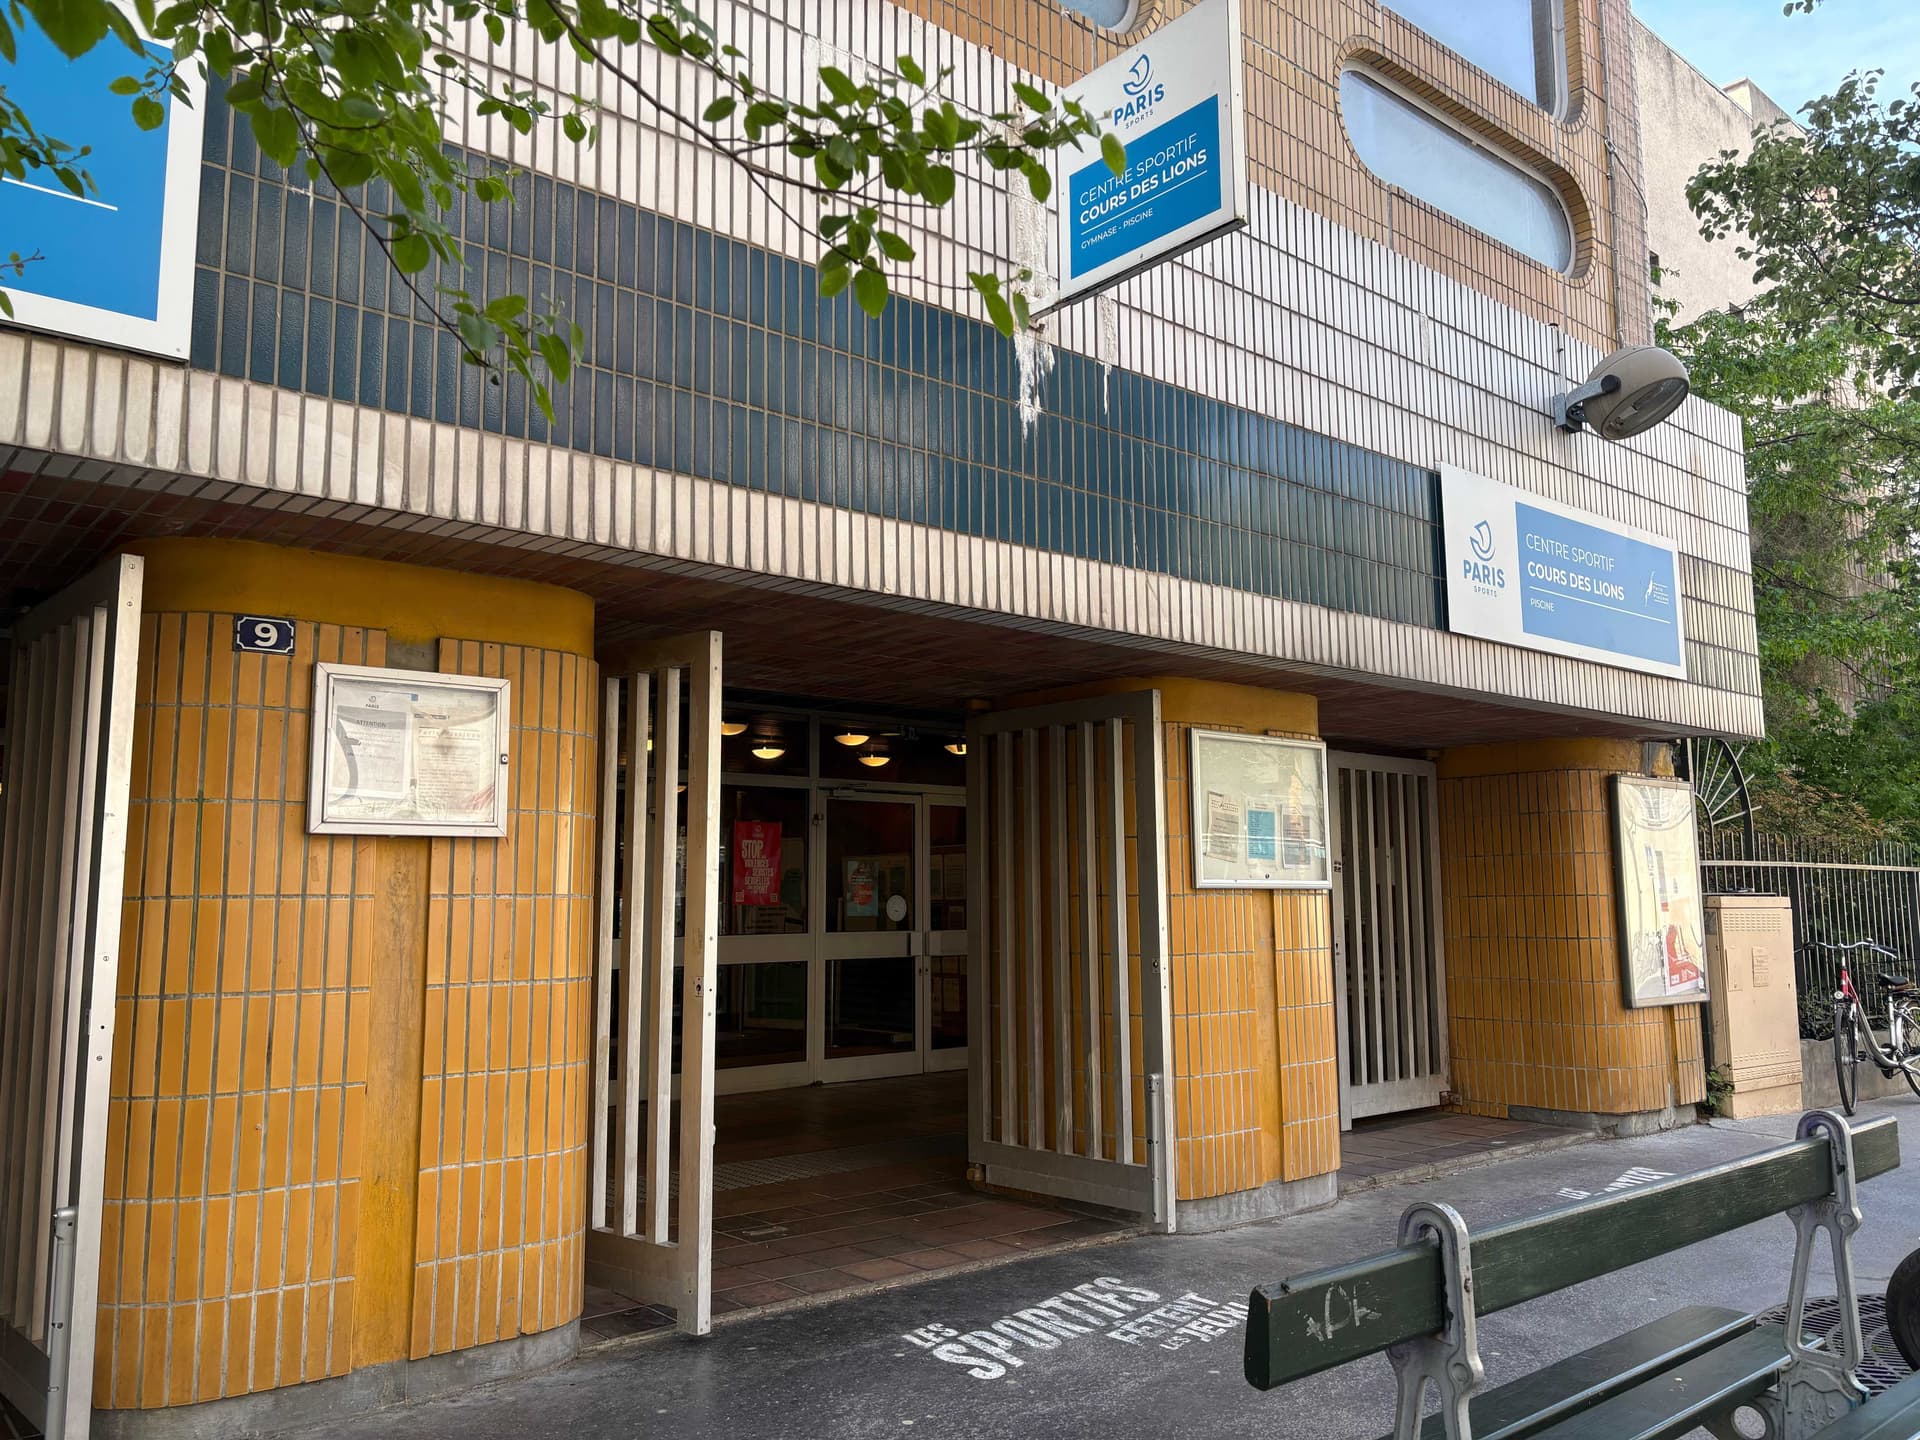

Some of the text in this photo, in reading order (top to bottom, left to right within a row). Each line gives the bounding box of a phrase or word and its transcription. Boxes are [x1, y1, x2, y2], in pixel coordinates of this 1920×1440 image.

[1114, 83, 1165, 126] PARIS
[1125, 109, 1154, 129] SPORTS
[1080, 133, 1198, 206] CENTRE SPORTIF
[1080, 149, 1208, 225] COURS DES LIONS
[1081, 225, 1118, 250] GYMNASE
[1123, 208, 1153, 227] PISCINE
[1526, 533, 1615, 572] CENTRE SPORTIF
[1463, 559, 1505, 588] PARIS
[1527, 560, 1625, 601] COURS DES LIONS
[1473, 585, 1497, 597] SPORTS
[1530, 598, 1555, 612] PISCINE
[254, 623, 278, 647] 9
[356, 720, 386, 728] ATTENTION
[742, 840, 764, 859] STOP
[902, 1322, 958, 1349] LES
[932, 1276, 1161, 1380] SPORTIFS
[1159, 1335, 1192, 1351] LES
